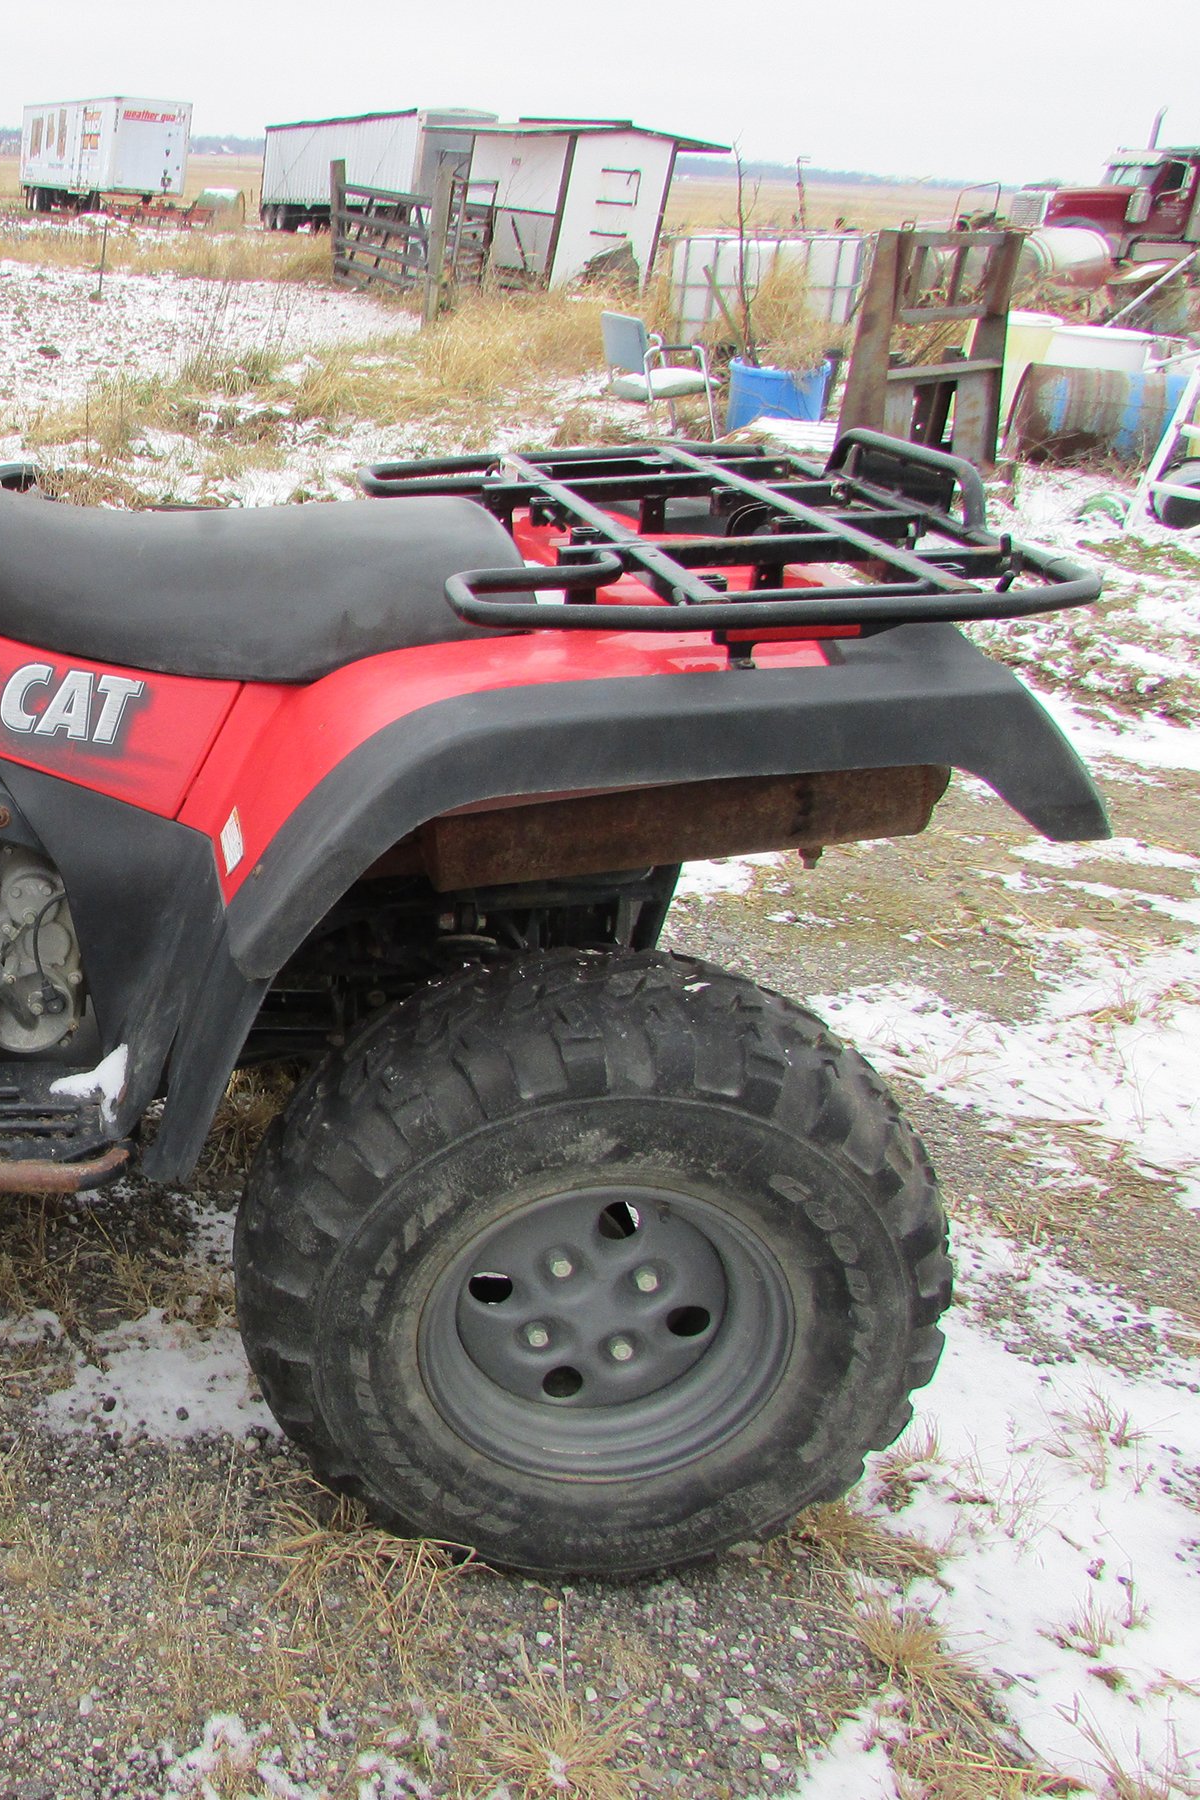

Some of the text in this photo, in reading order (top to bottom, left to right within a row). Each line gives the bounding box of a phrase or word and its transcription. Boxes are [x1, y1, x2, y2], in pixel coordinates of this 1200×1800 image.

[123, 110, 160, 121] weather
[161, 112, 186, 123] guad
[0, 663, 145, 744] CAT
